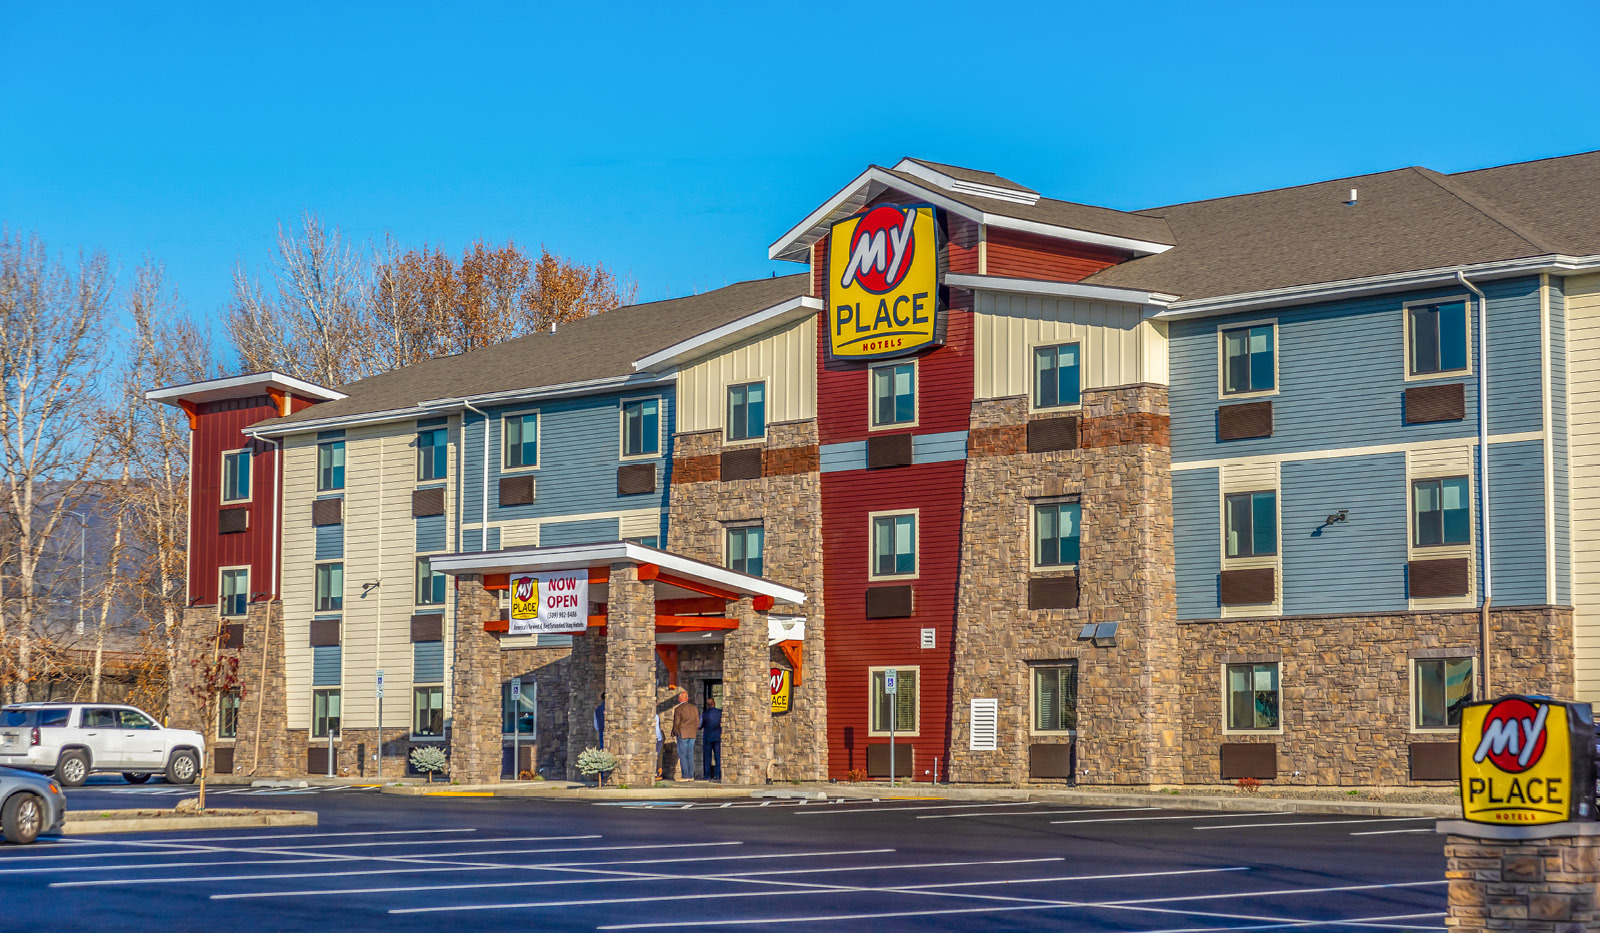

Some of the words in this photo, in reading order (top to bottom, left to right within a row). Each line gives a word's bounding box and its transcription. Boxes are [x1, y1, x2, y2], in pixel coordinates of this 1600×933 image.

[837, 292, 928, 336] PLACE
[862, 338, 903, 351] HOTELS
[548, 577, 576, 591] NOW
[513, 603, 537, 613] PLACE
[547, 594, 578, 608] OPEN
[772, 696, 787, 705] ACE
[1469, 777, 1562, 804] PLACE
